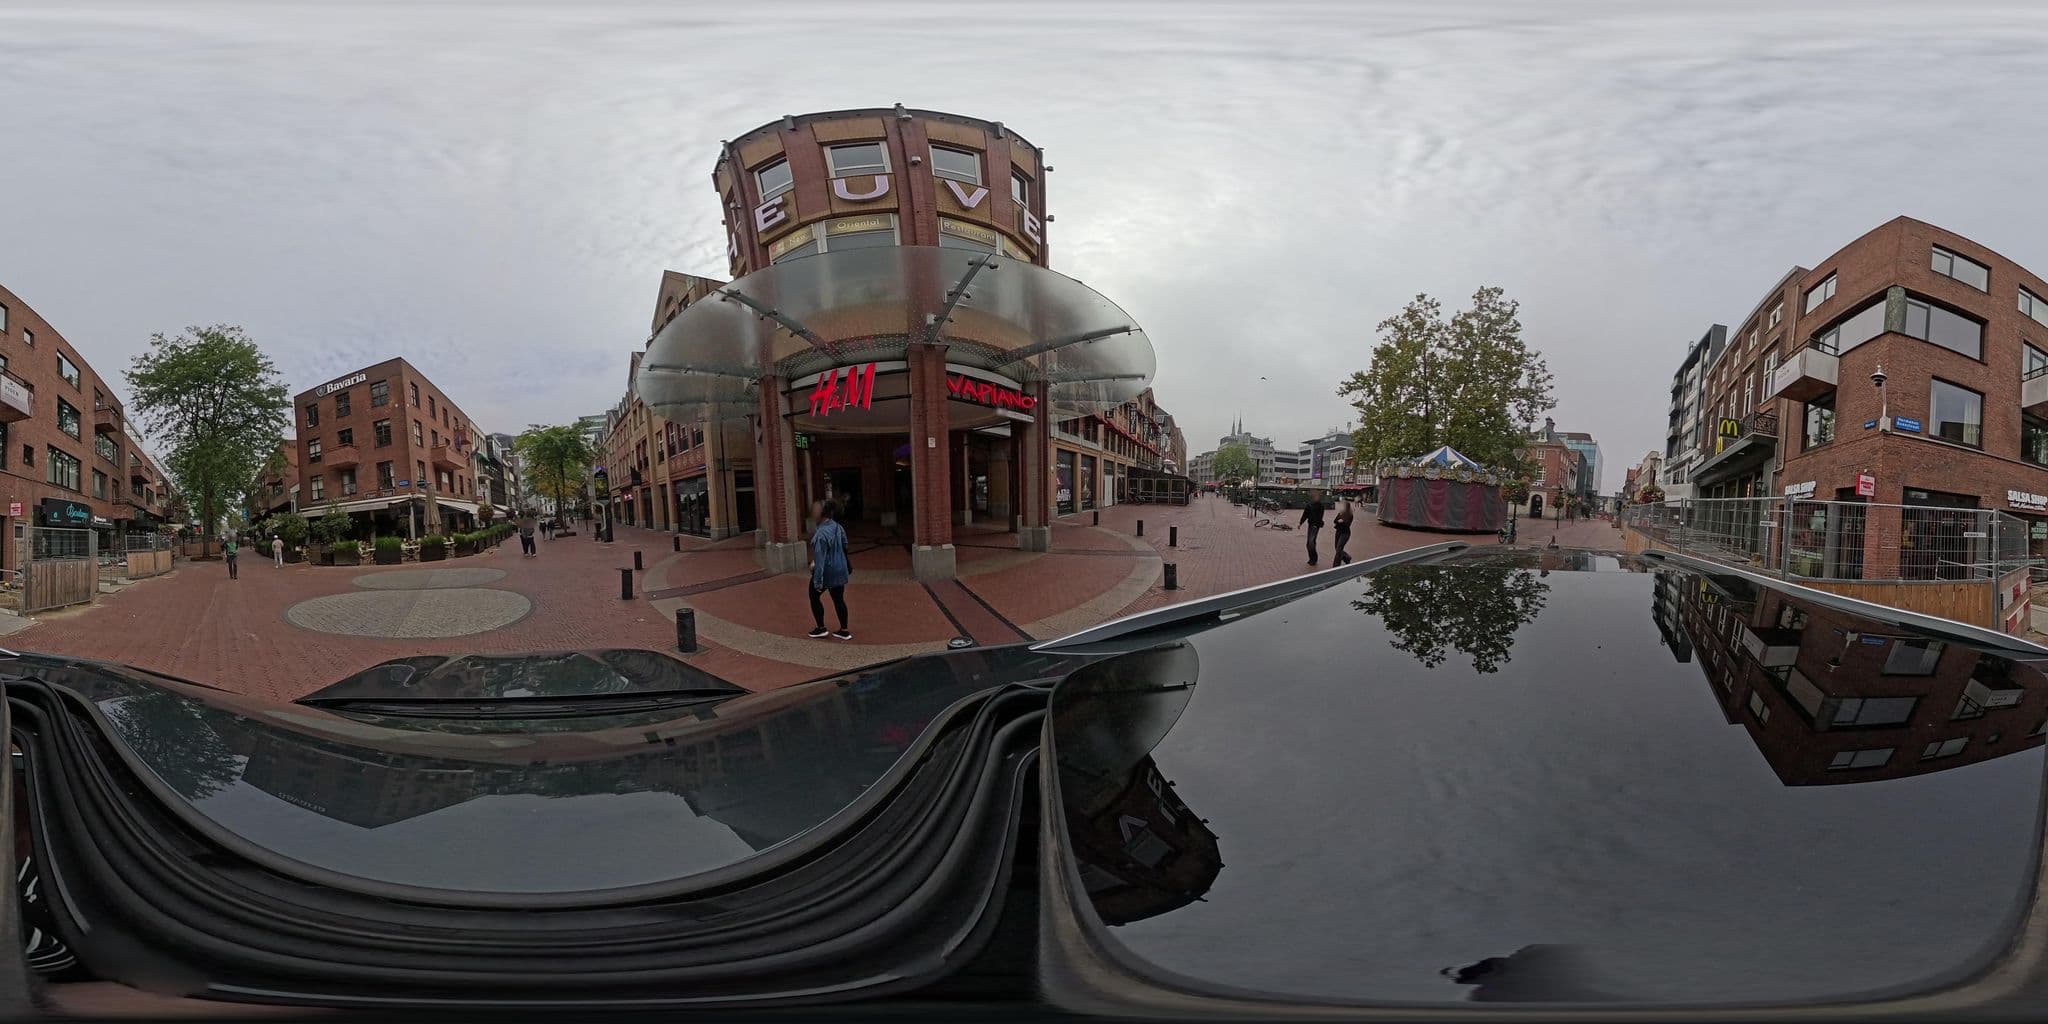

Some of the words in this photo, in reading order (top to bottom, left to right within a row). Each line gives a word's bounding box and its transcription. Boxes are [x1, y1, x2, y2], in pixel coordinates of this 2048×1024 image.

[837, 218, 880, 229] Oriental
[943, 221, 996, 240] Restaurant
[326, 373, 367, 394] Bavaria
[808, 361, 876, 416] H&M
[946, 375, 1034, 408] VAPIANO
[2007, 490, 2031, 503] SALSA
